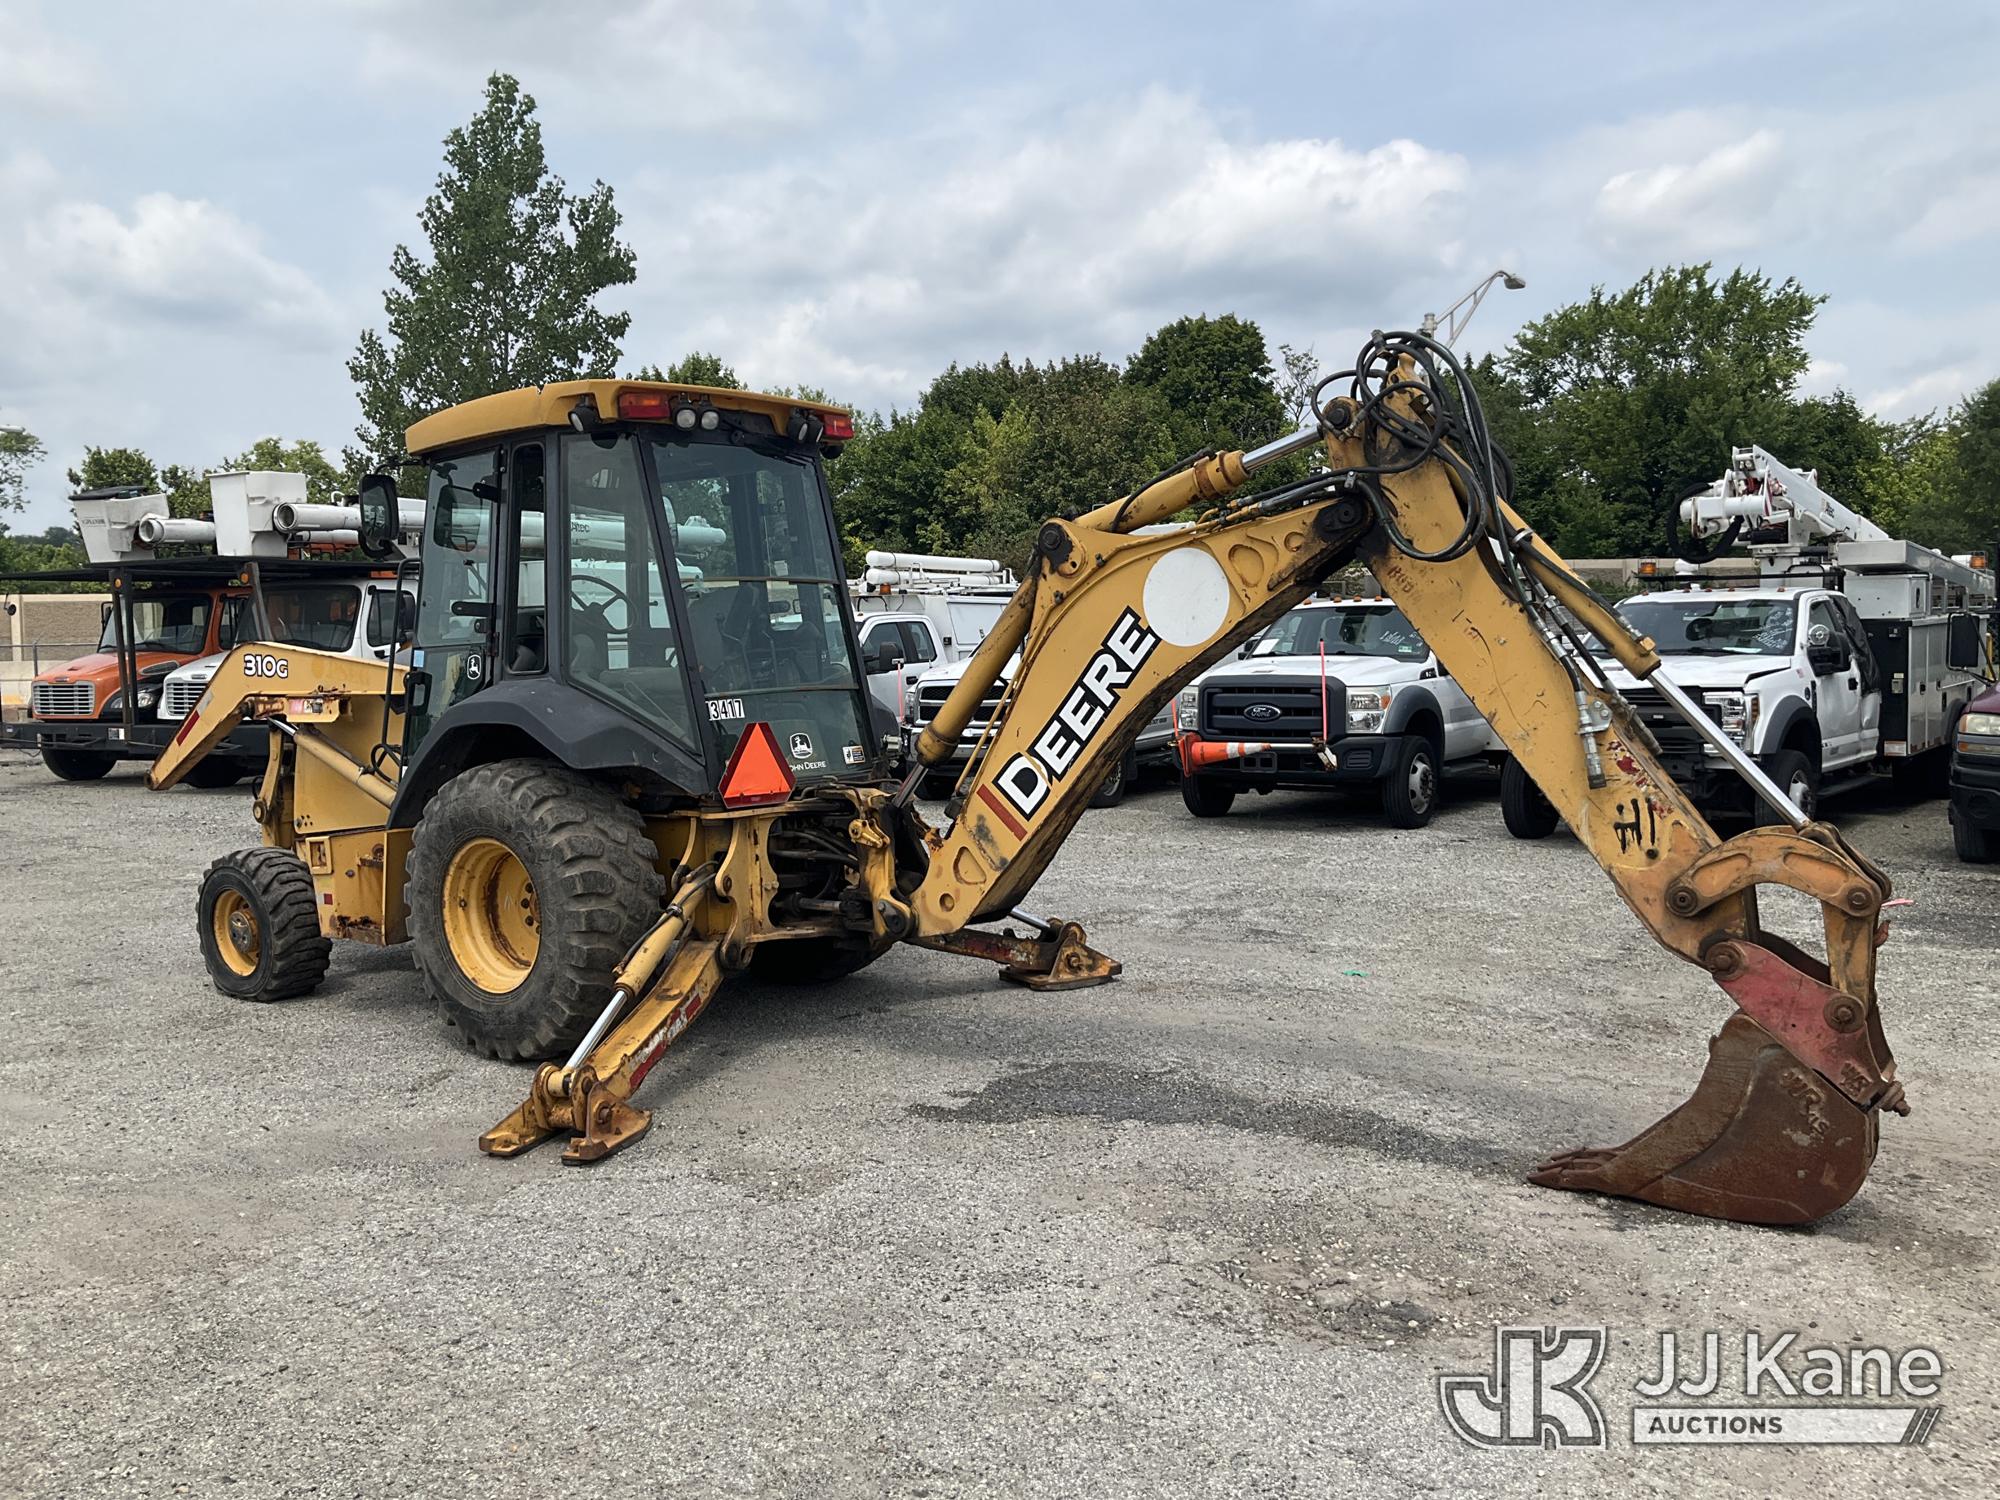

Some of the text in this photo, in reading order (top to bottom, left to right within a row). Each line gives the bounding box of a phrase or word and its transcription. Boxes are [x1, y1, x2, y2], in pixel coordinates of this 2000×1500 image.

[243, 653, 289, 679] 310G
[994, 608, 1159, 818] DEERE
[804, 760, 827, 770] DEERE
